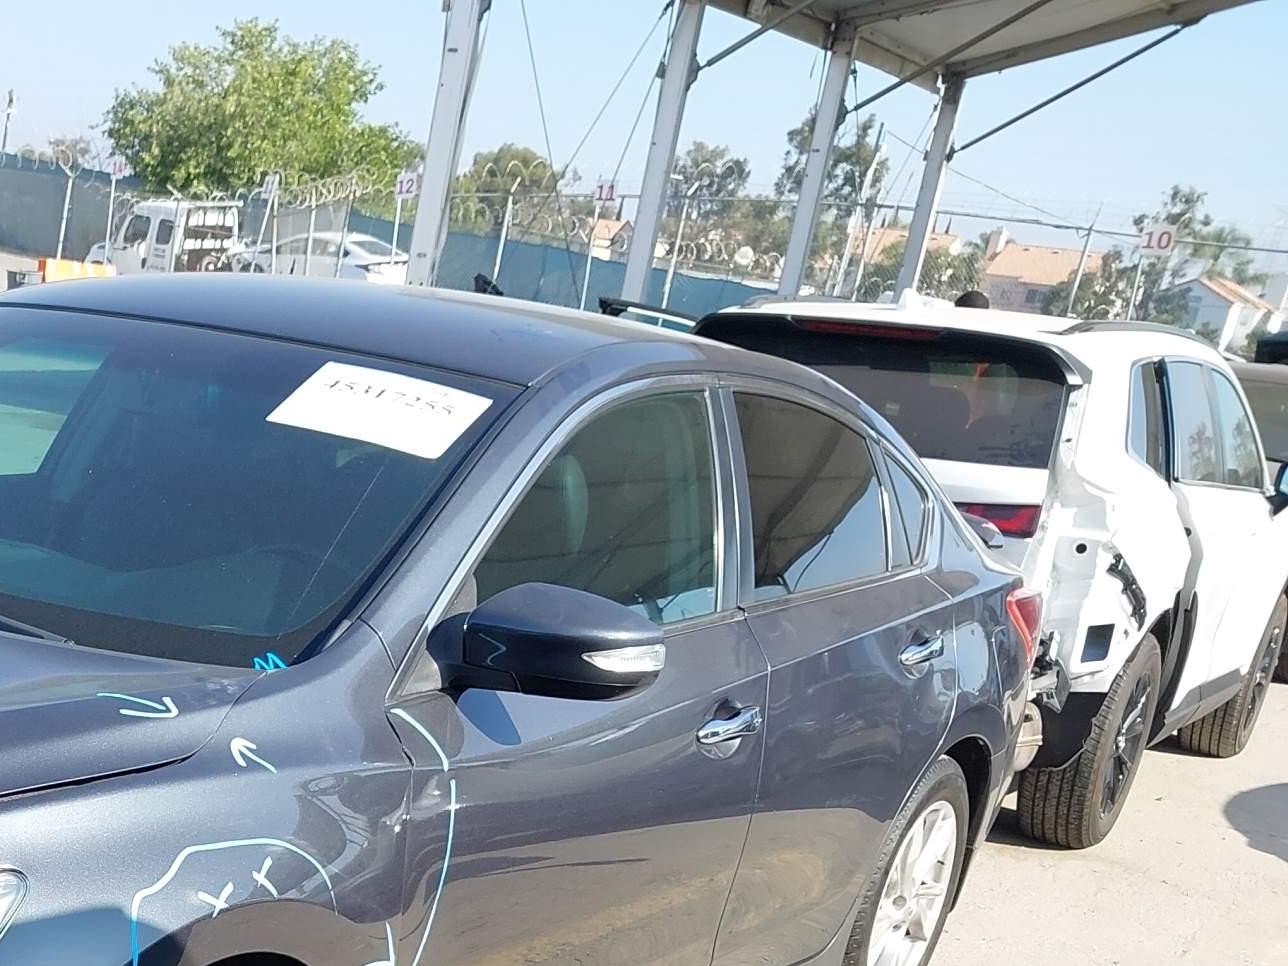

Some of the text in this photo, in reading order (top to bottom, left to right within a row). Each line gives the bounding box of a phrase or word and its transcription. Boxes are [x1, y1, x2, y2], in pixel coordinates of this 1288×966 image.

[397, 178, 414, 195] 12
[595, 183, 615, 201] 11
[1142, 230, 1173, 250] 10
